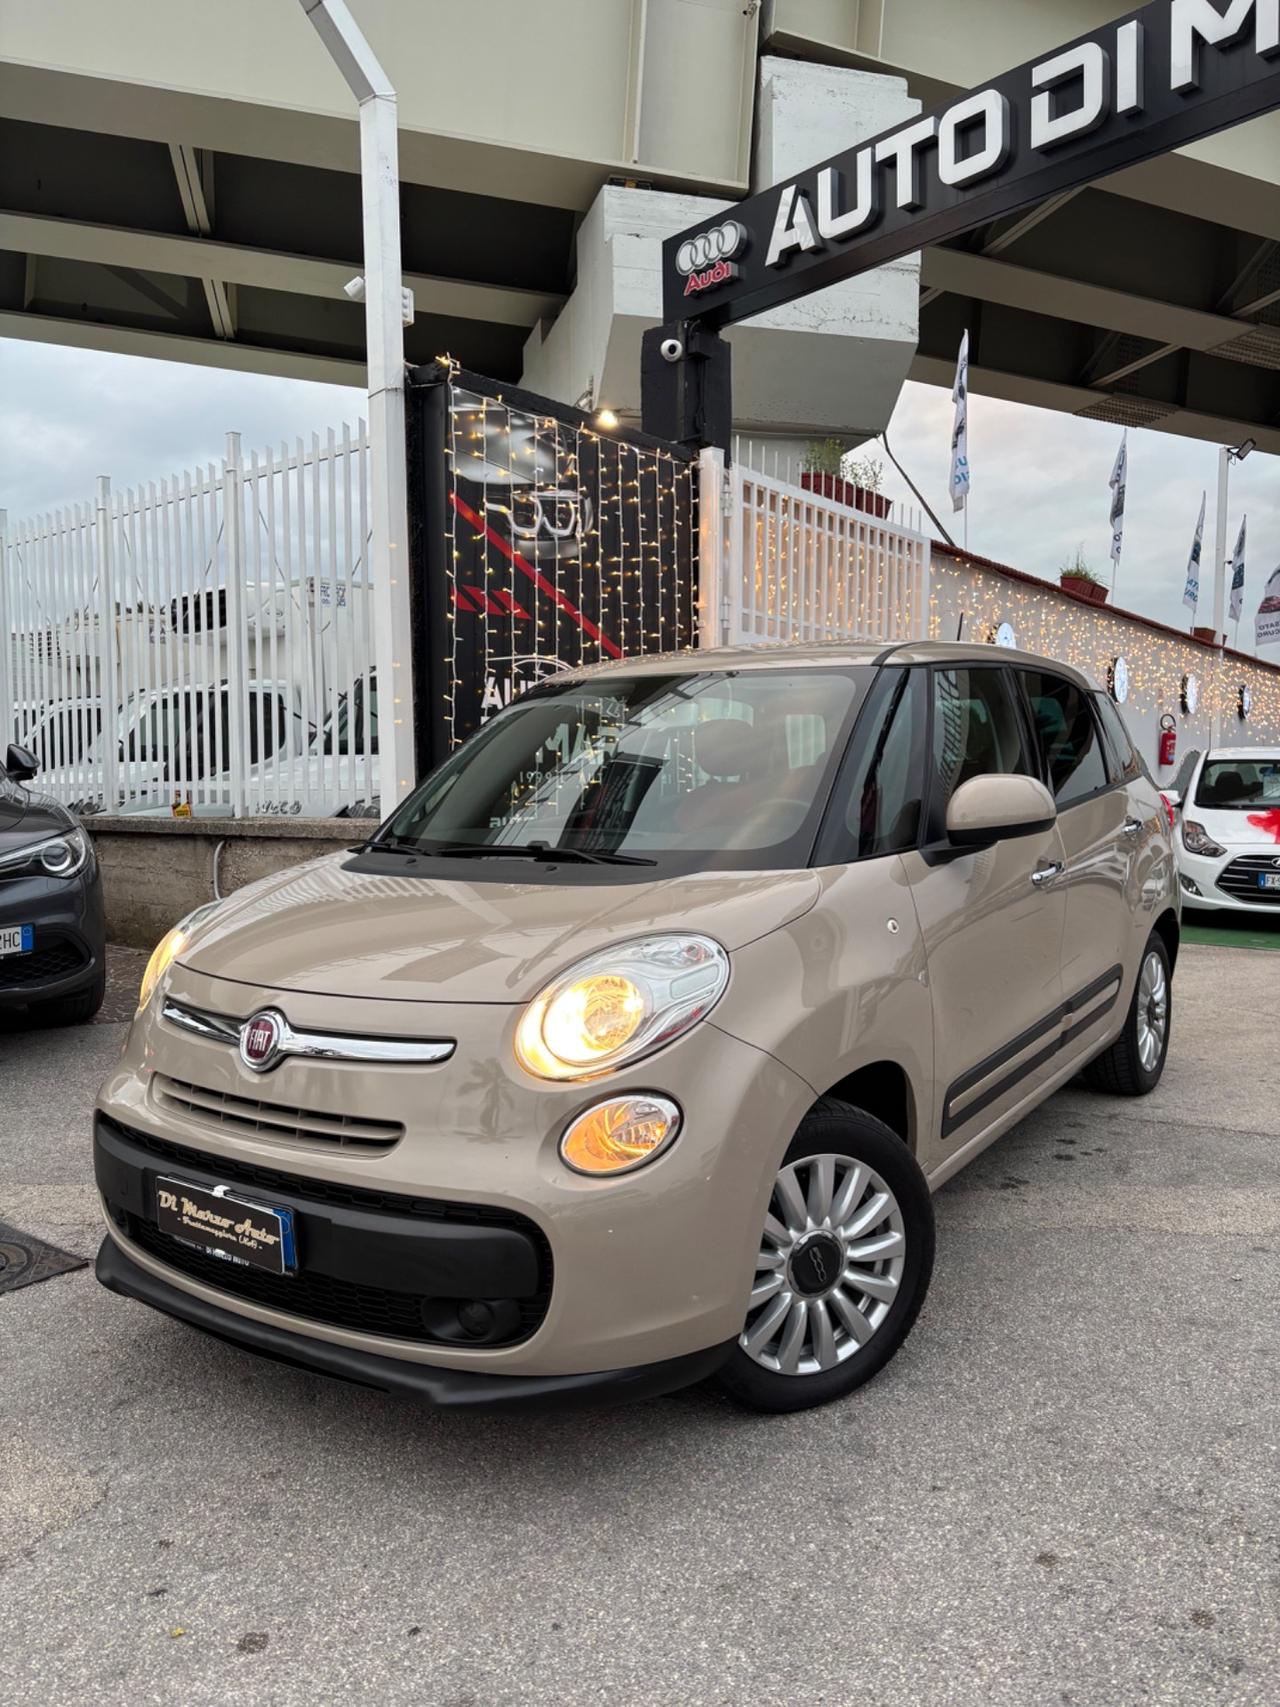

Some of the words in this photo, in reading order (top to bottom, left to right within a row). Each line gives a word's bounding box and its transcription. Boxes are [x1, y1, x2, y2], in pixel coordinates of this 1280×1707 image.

[765, 89, 1008, 268] AUTO
[1031, 19, 1143, 152] DI
[684, 261, 734, 296] Audi
[481, 677, 538, 710] AU
[0, 931, 20, 949] HC
[248, 1028, 271, 1052] FIAT
